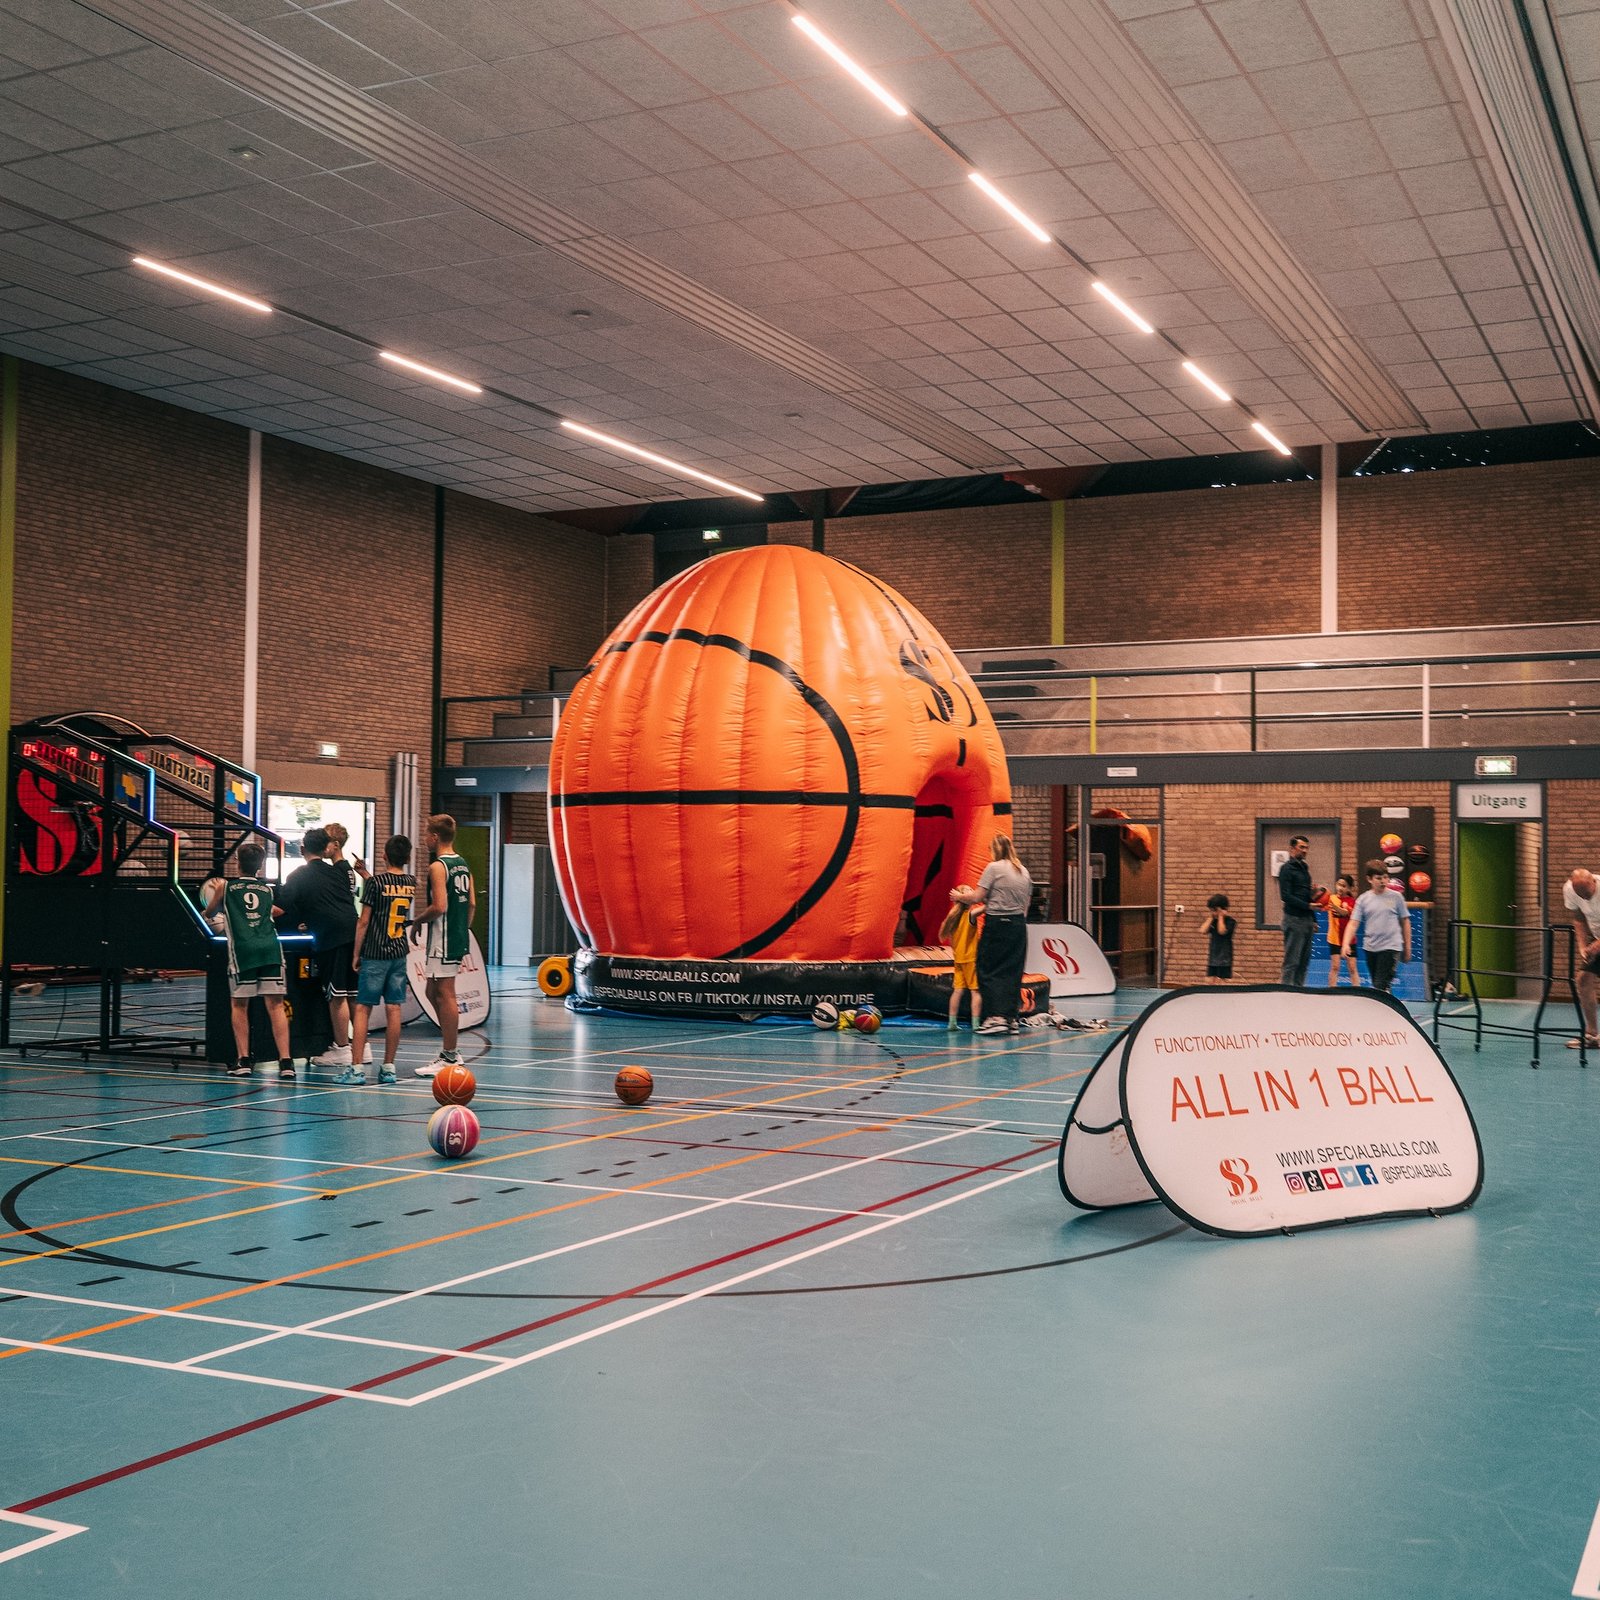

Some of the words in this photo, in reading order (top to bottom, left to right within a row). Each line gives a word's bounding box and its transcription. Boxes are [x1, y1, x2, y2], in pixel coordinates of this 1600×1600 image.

[1471, 794, 1527, 809] Uitgang
[454, 874, 470, 894] 90
[243, 892, 260, 910] 9
[610, 968, 741, 984] WWW.SPECIALBALLS.COM
[659, 991, 676, 1003] ON
[678, 992, 693, 1003] FB
[704, 993, 751, 1005] TIKTOK
[763, 994, 802, 1005] INSTA
[815, 993, 875, 1005] YOUTUBE
[1154, 1033, 1260, 1053] FUNCTIONALITY
[1271, 1032, 1352, 1048] TECHNOLOGY
[1363, 1031, 1408, 1047] QUALITY
[1171, 1073, 1249, 1122] ALL
[1254, 1069, 1300, 1112] IN
[1309, 1068, 1329, 1107] 1
[1337, 1065, 1434, 1106] BALL
[1275, 1140, 1441, 1168] WWW.SPECIALBALLS.COM
[1381, 1162, 1452, 1184] @SPECIALBALLS
